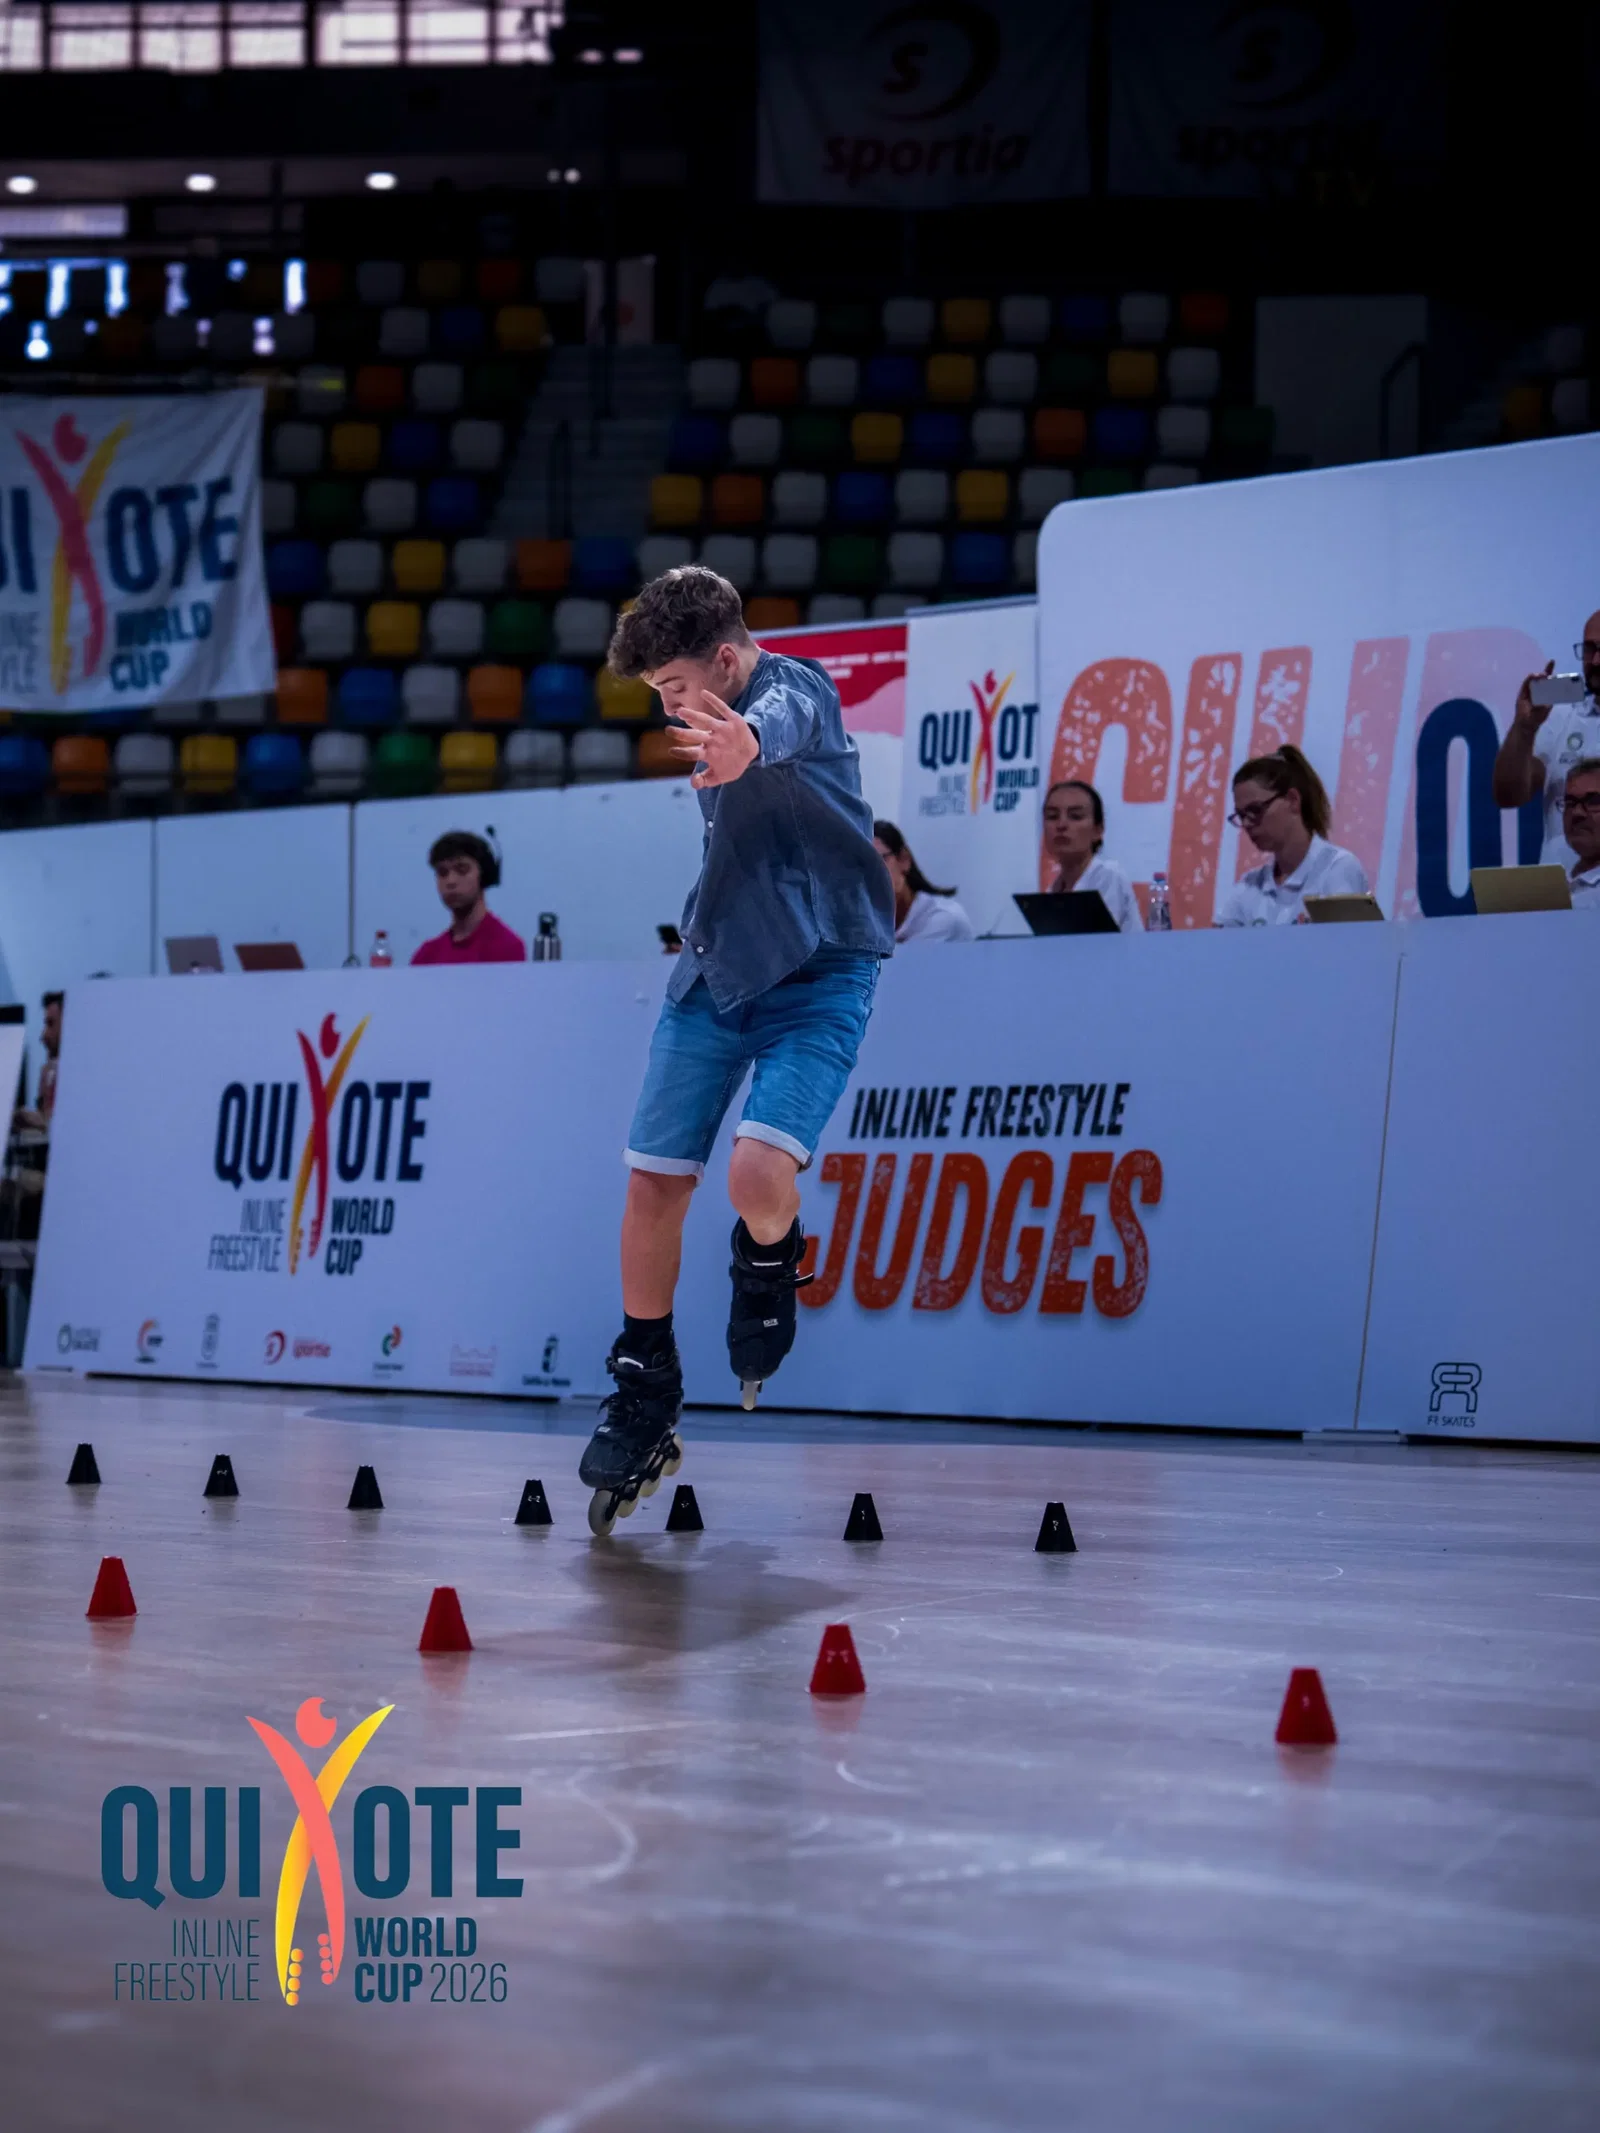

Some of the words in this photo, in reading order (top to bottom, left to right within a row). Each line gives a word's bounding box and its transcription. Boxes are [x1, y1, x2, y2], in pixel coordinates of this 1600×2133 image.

[823, 124, 1031, 188] sportia
[108, 649, 171, 691] CUP
[993, 791, 1020, 812] CUP
[849, 1086, 957, 1139] INLINE
[961, 1083, 1131, 1137] FREESTYLE
[240, 1199, 286, 1234] INLINE
[331, 1197, 395, 1235] WORLD
[797, 1149, 1163, 1318] JUDGES
[207, 1235, 282, 1272] FREESTYLE
[325, 1238, 363, 1275] CUP
